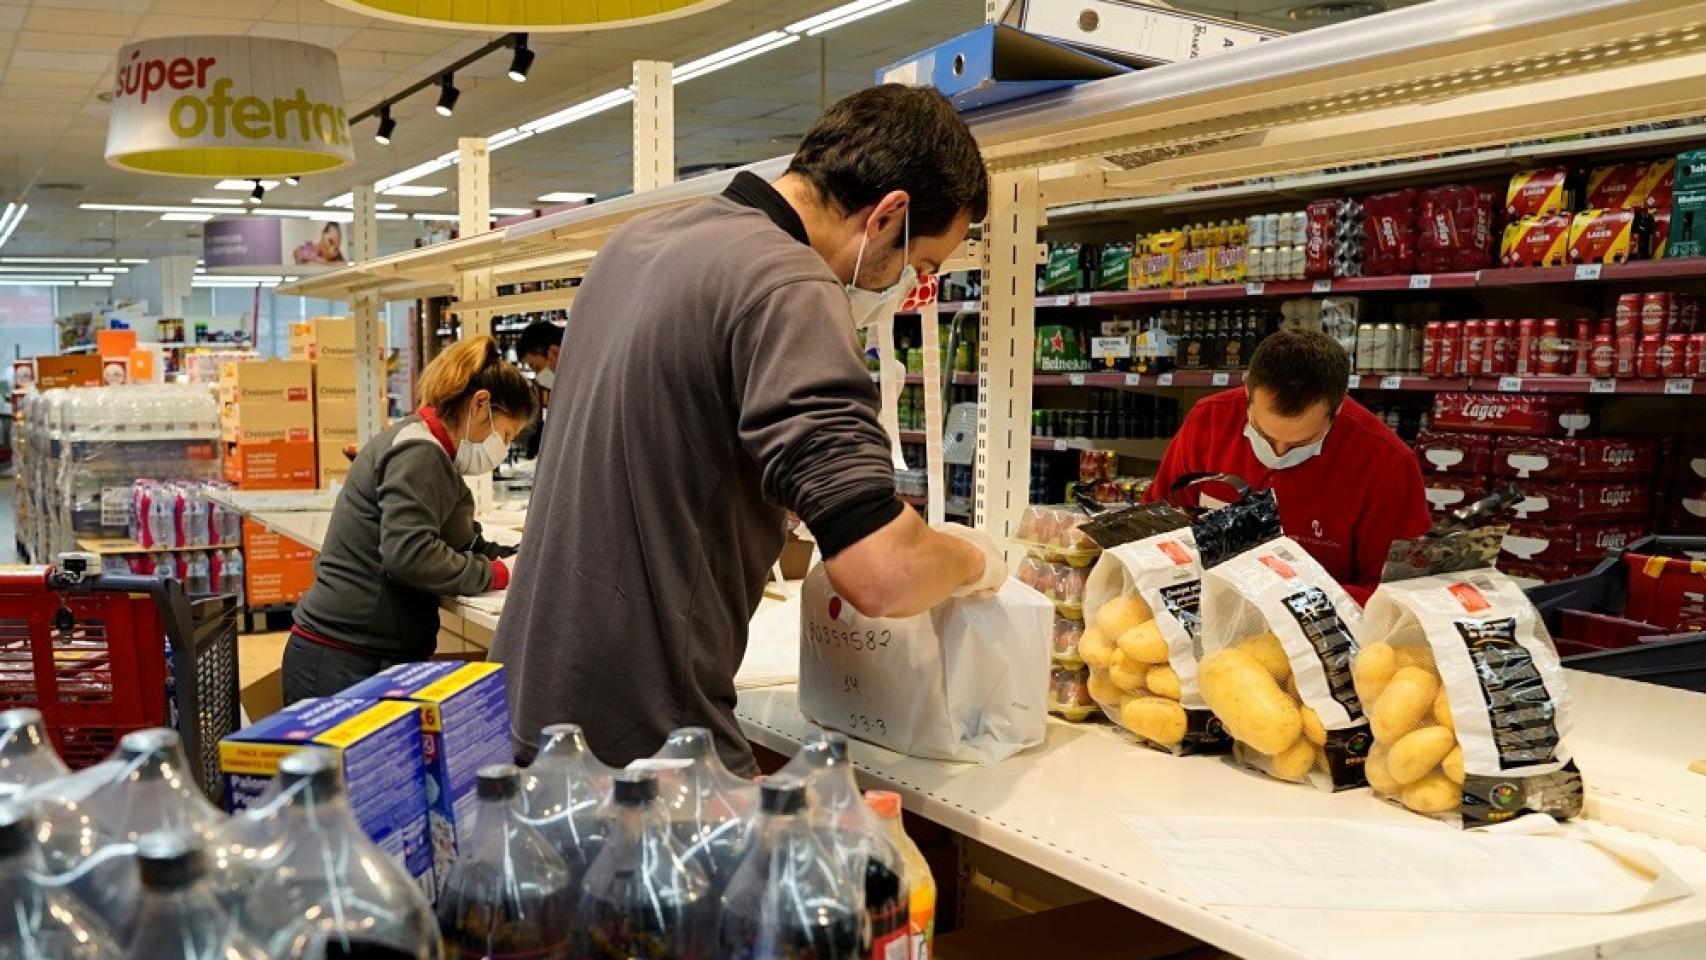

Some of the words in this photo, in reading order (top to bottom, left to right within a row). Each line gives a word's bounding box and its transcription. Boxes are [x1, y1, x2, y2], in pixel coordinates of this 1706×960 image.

[116, 49, 216, 104] súper
[168, 78, 350, 146] ofertas
[1522, 186, 1546, 197] LAGER
[1601, 183, 1627, 193] LAGER
[1526, 234, 1551, 243] LAGER
[1586, 230, 1612, 240] LAGER
[1461, 399, 1506, 421] Lager
[1601, 446, 1636, 466] Lager
[1599, 487, 1632, 507] Lager
[1594, 530, 1628, 551] Lager
